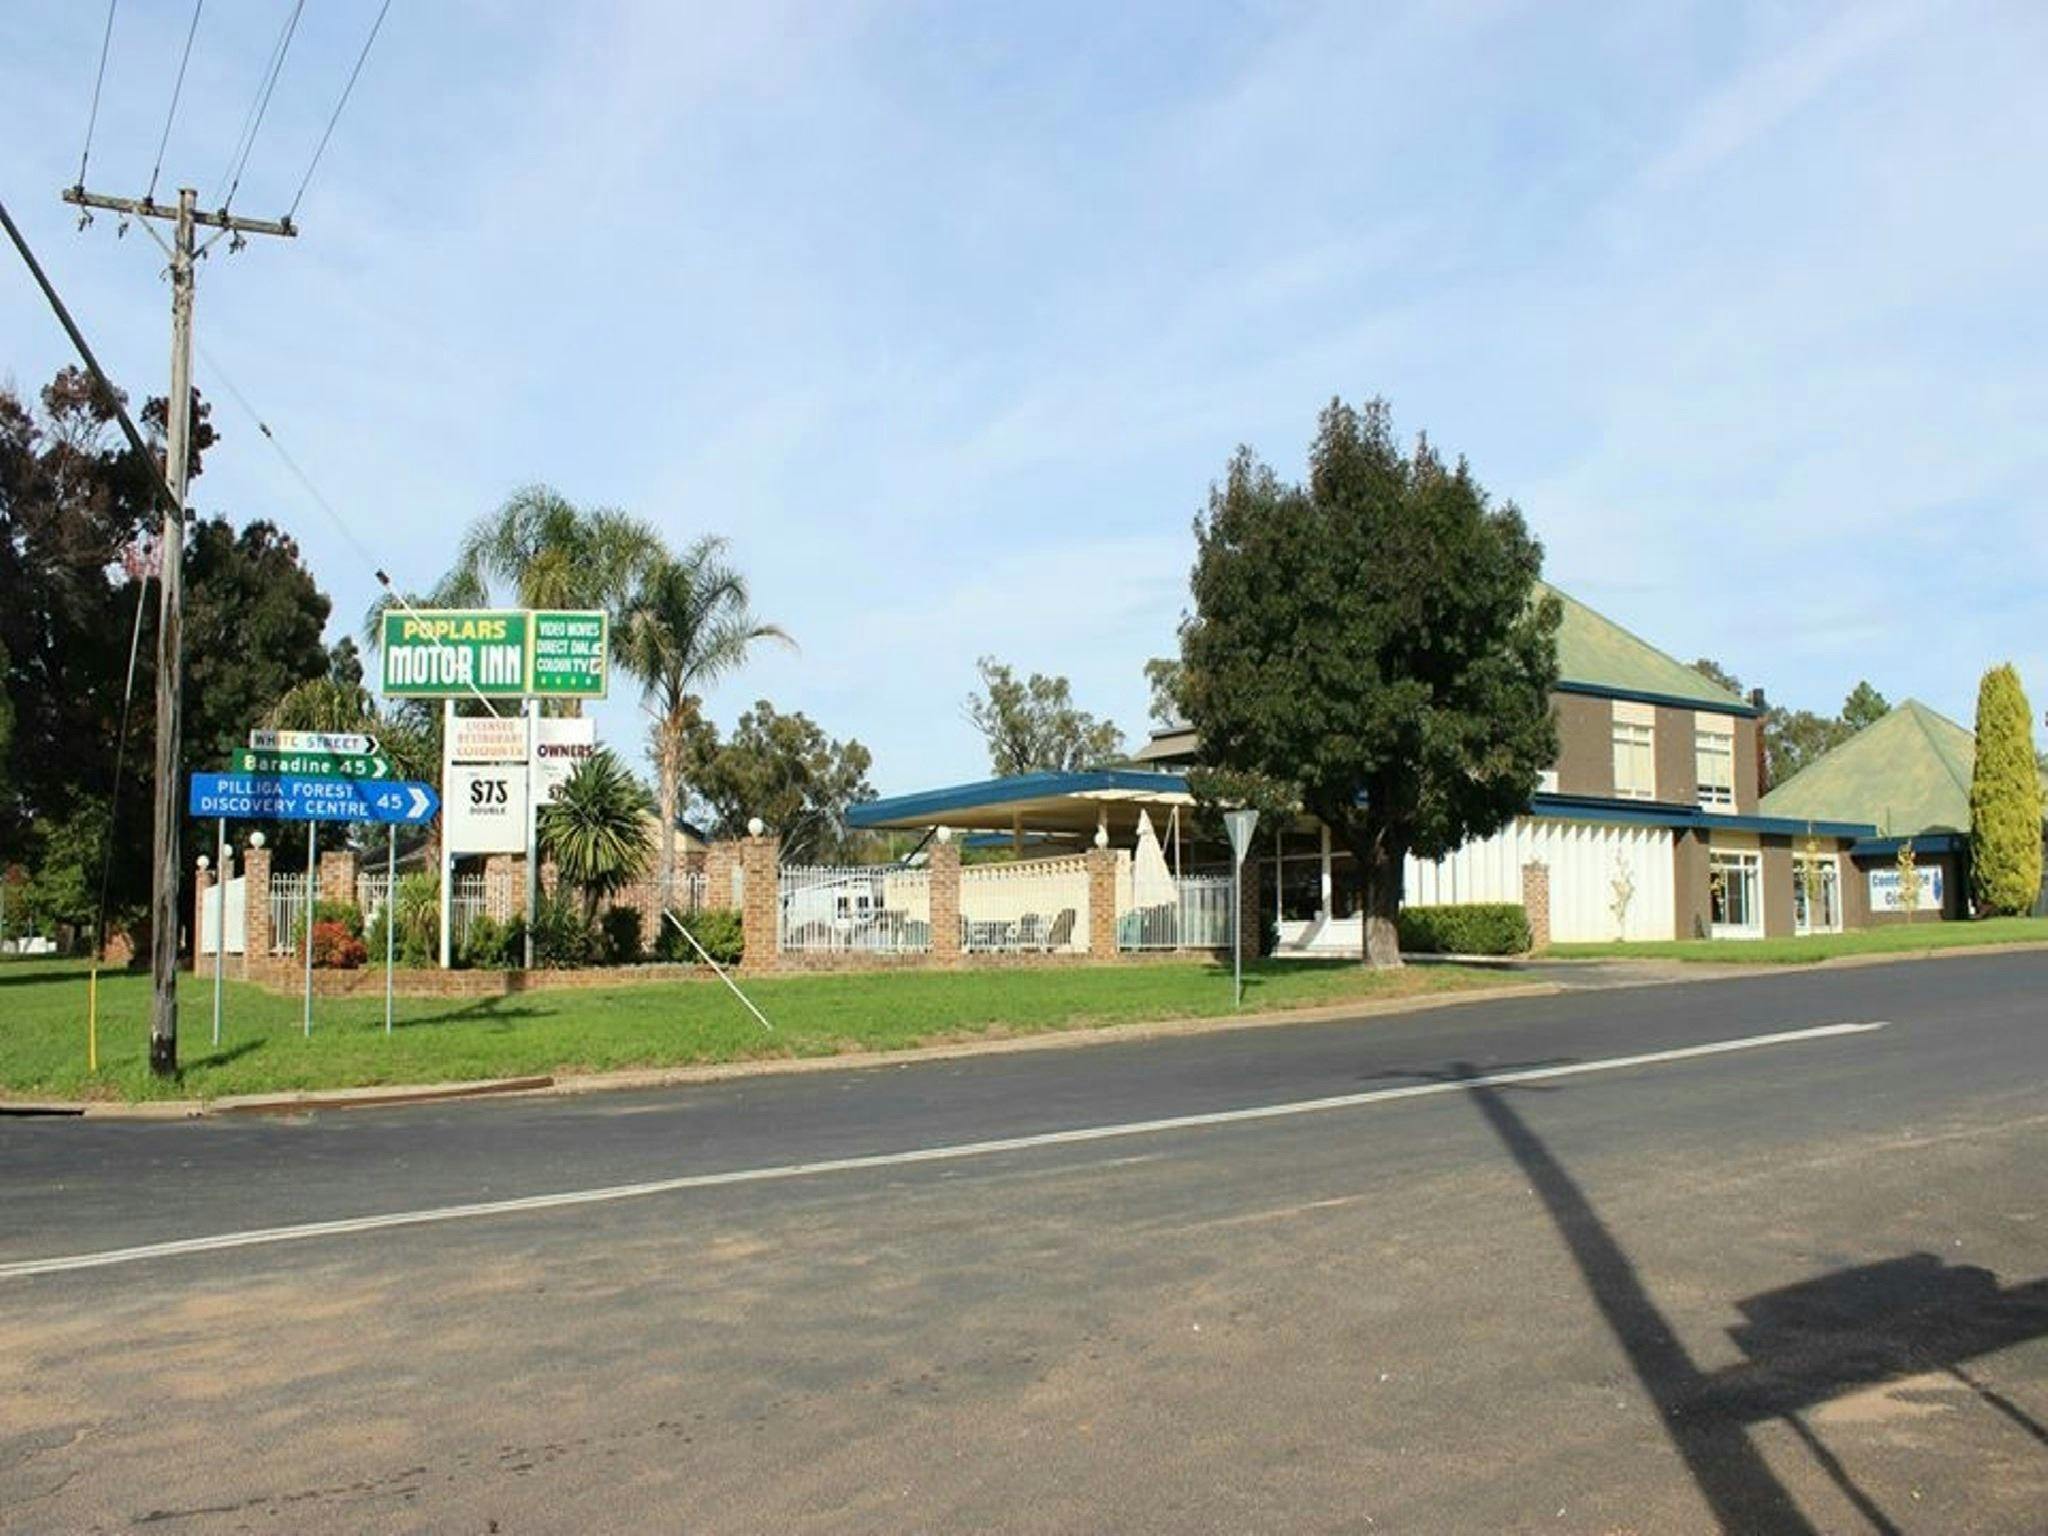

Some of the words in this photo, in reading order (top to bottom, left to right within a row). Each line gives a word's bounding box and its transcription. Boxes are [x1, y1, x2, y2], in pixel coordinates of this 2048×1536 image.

[403, 619, 507, 641] POPLARS
[387, 645, 474, 685] MOTOR
[480, 645, 522, 685] INN
[255, 735, 298, 748] WHITE
[306, 736, 361, 751] STREET
[537, 744, 594, 758] OWNERS
[244, 754, 331, 774] Baradine
[339, 759, 368, 775] 45
[217, 779, 284, 797] PILLIGA
[292, 783, 354, 799] FOREST
[470, 778, 508, 804] $75
[201, 797, 297, 814] DISCOVERY
[305, 800, 369, 817] CENTRE
[376, 794, 403, 811] 45
